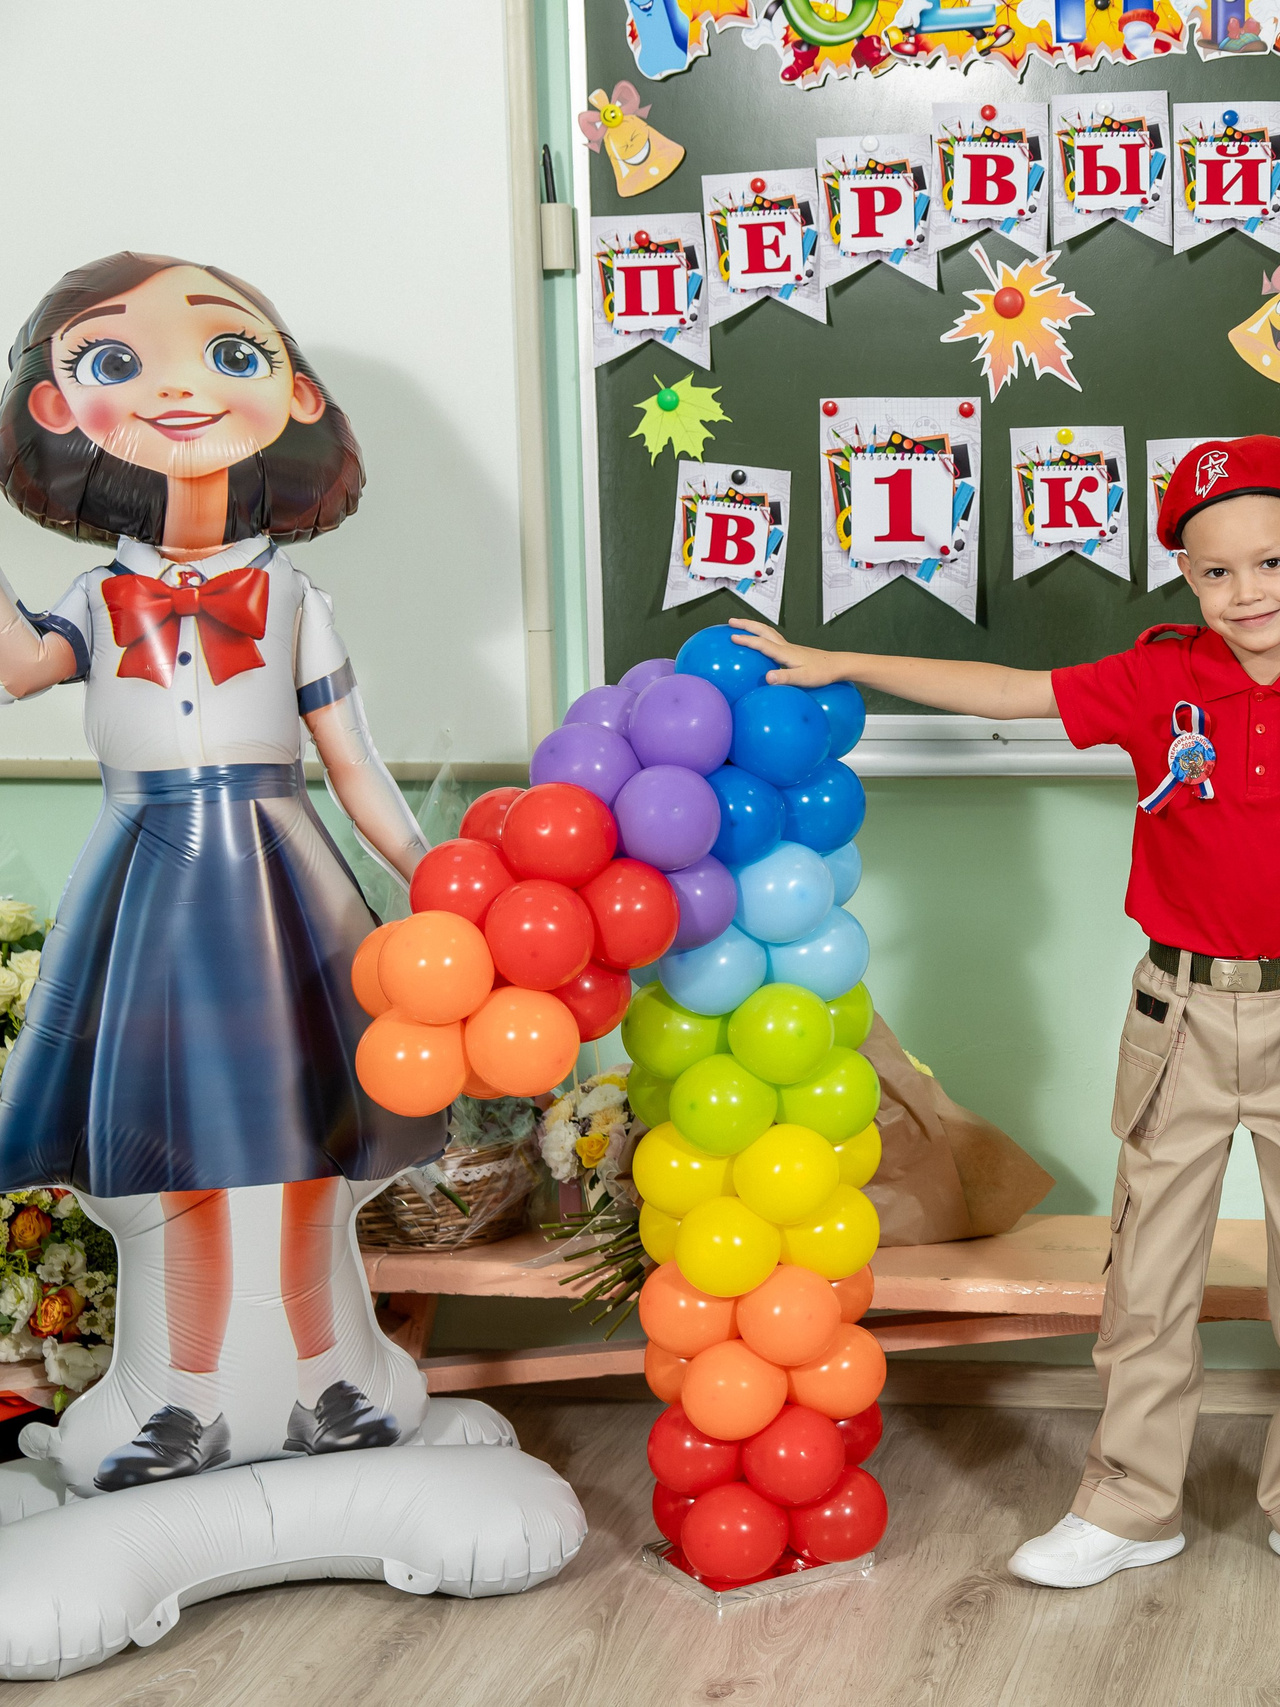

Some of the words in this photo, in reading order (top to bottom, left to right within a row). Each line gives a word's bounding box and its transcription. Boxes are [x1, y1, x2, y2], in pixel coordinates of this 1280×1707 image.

[616, 142, 1267, 317] ПЕРВЫЙ
[701, 511, 756, 566] В
[873, 468, 926, 543] 1
[1170, 735, 1210, 760] ПЕРВОКЛАССНИК
[1181, 741, 1196, 749] 2025
